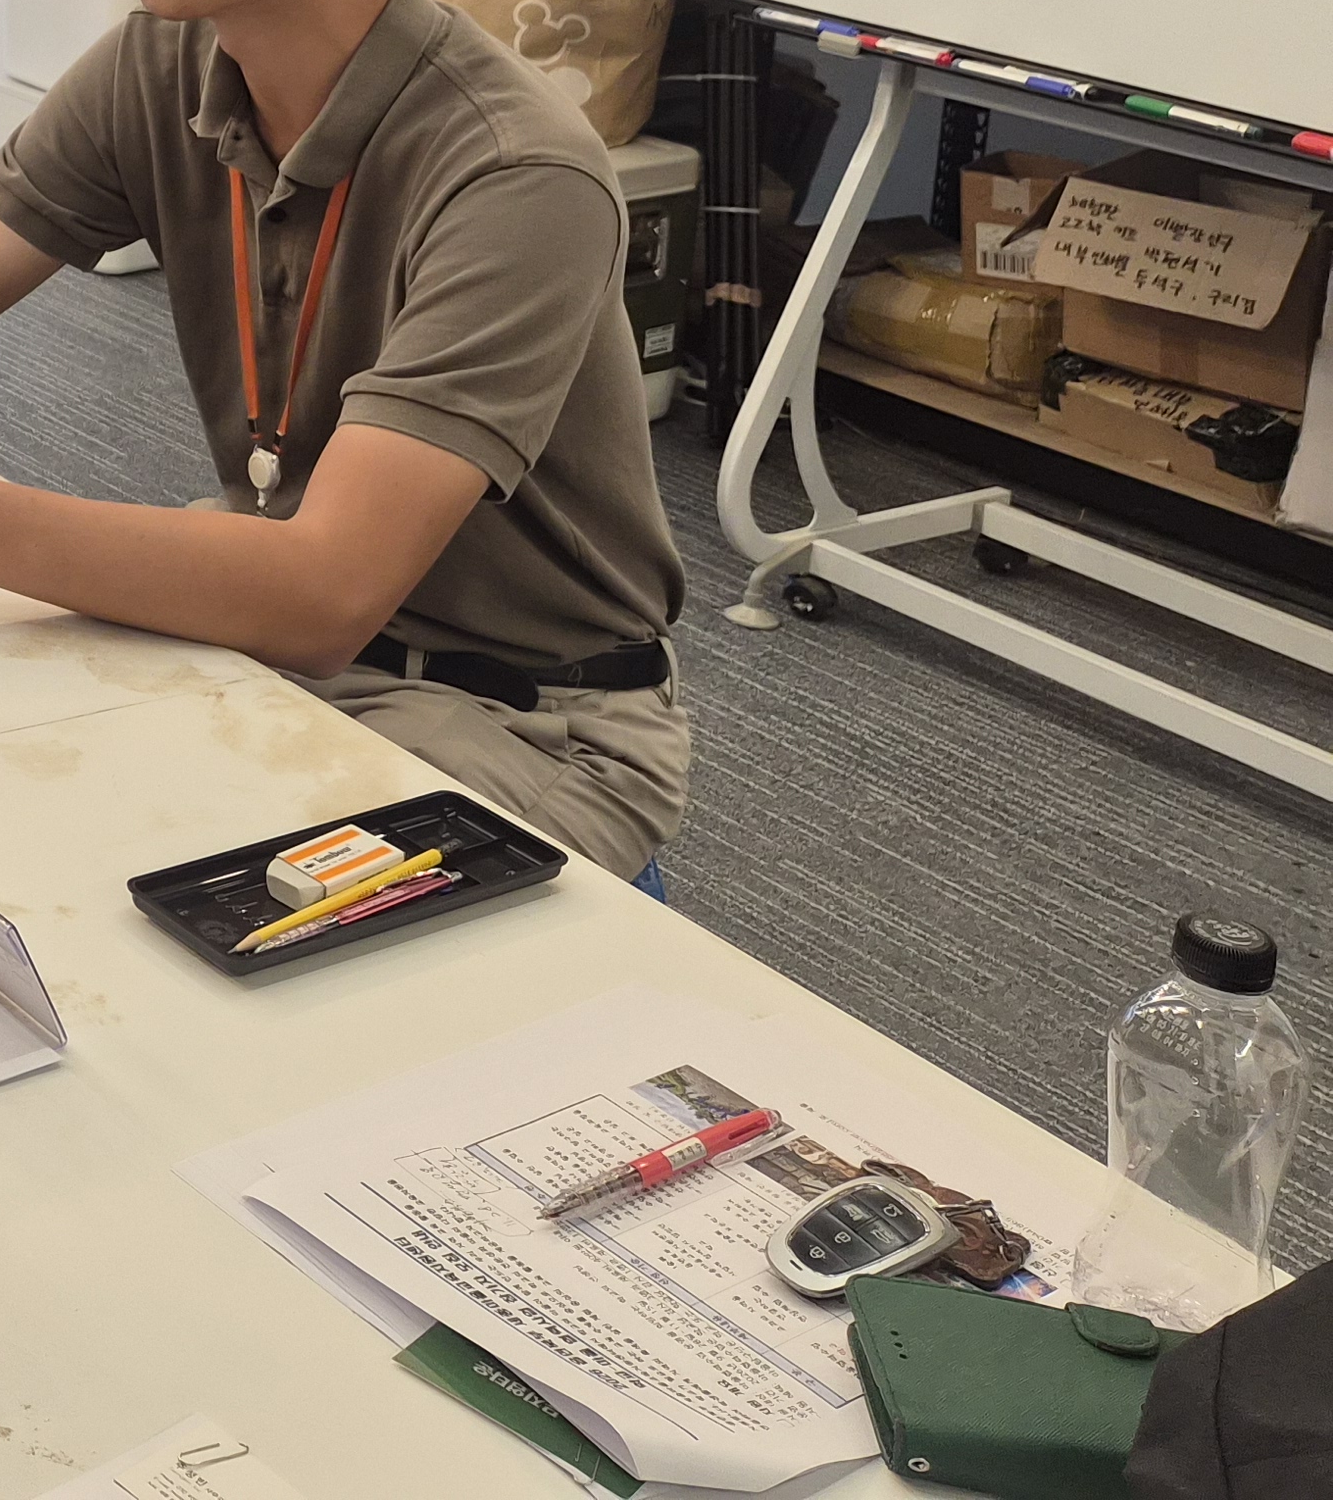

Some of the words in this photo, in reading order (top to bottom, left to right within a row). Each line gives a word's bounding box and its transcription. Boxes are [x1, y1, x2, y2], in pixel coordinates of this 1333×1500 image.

[313, 845, 351, 864] Tombow
[409, 1228, 443, 1250] 안내
[441, 1251, 475, 1273] 모집
[392, 1236, 528, 1327] 세종마을교육지원센터
[518, 1306, 577, 1344] 협력사업
[527, 1328, 587, 1367] 읍면북부
[589, 1366, 629, 1392] 2026
[716, 1378, 745, 1396] 개요
[746, 1398, 773, 1416] 지원
